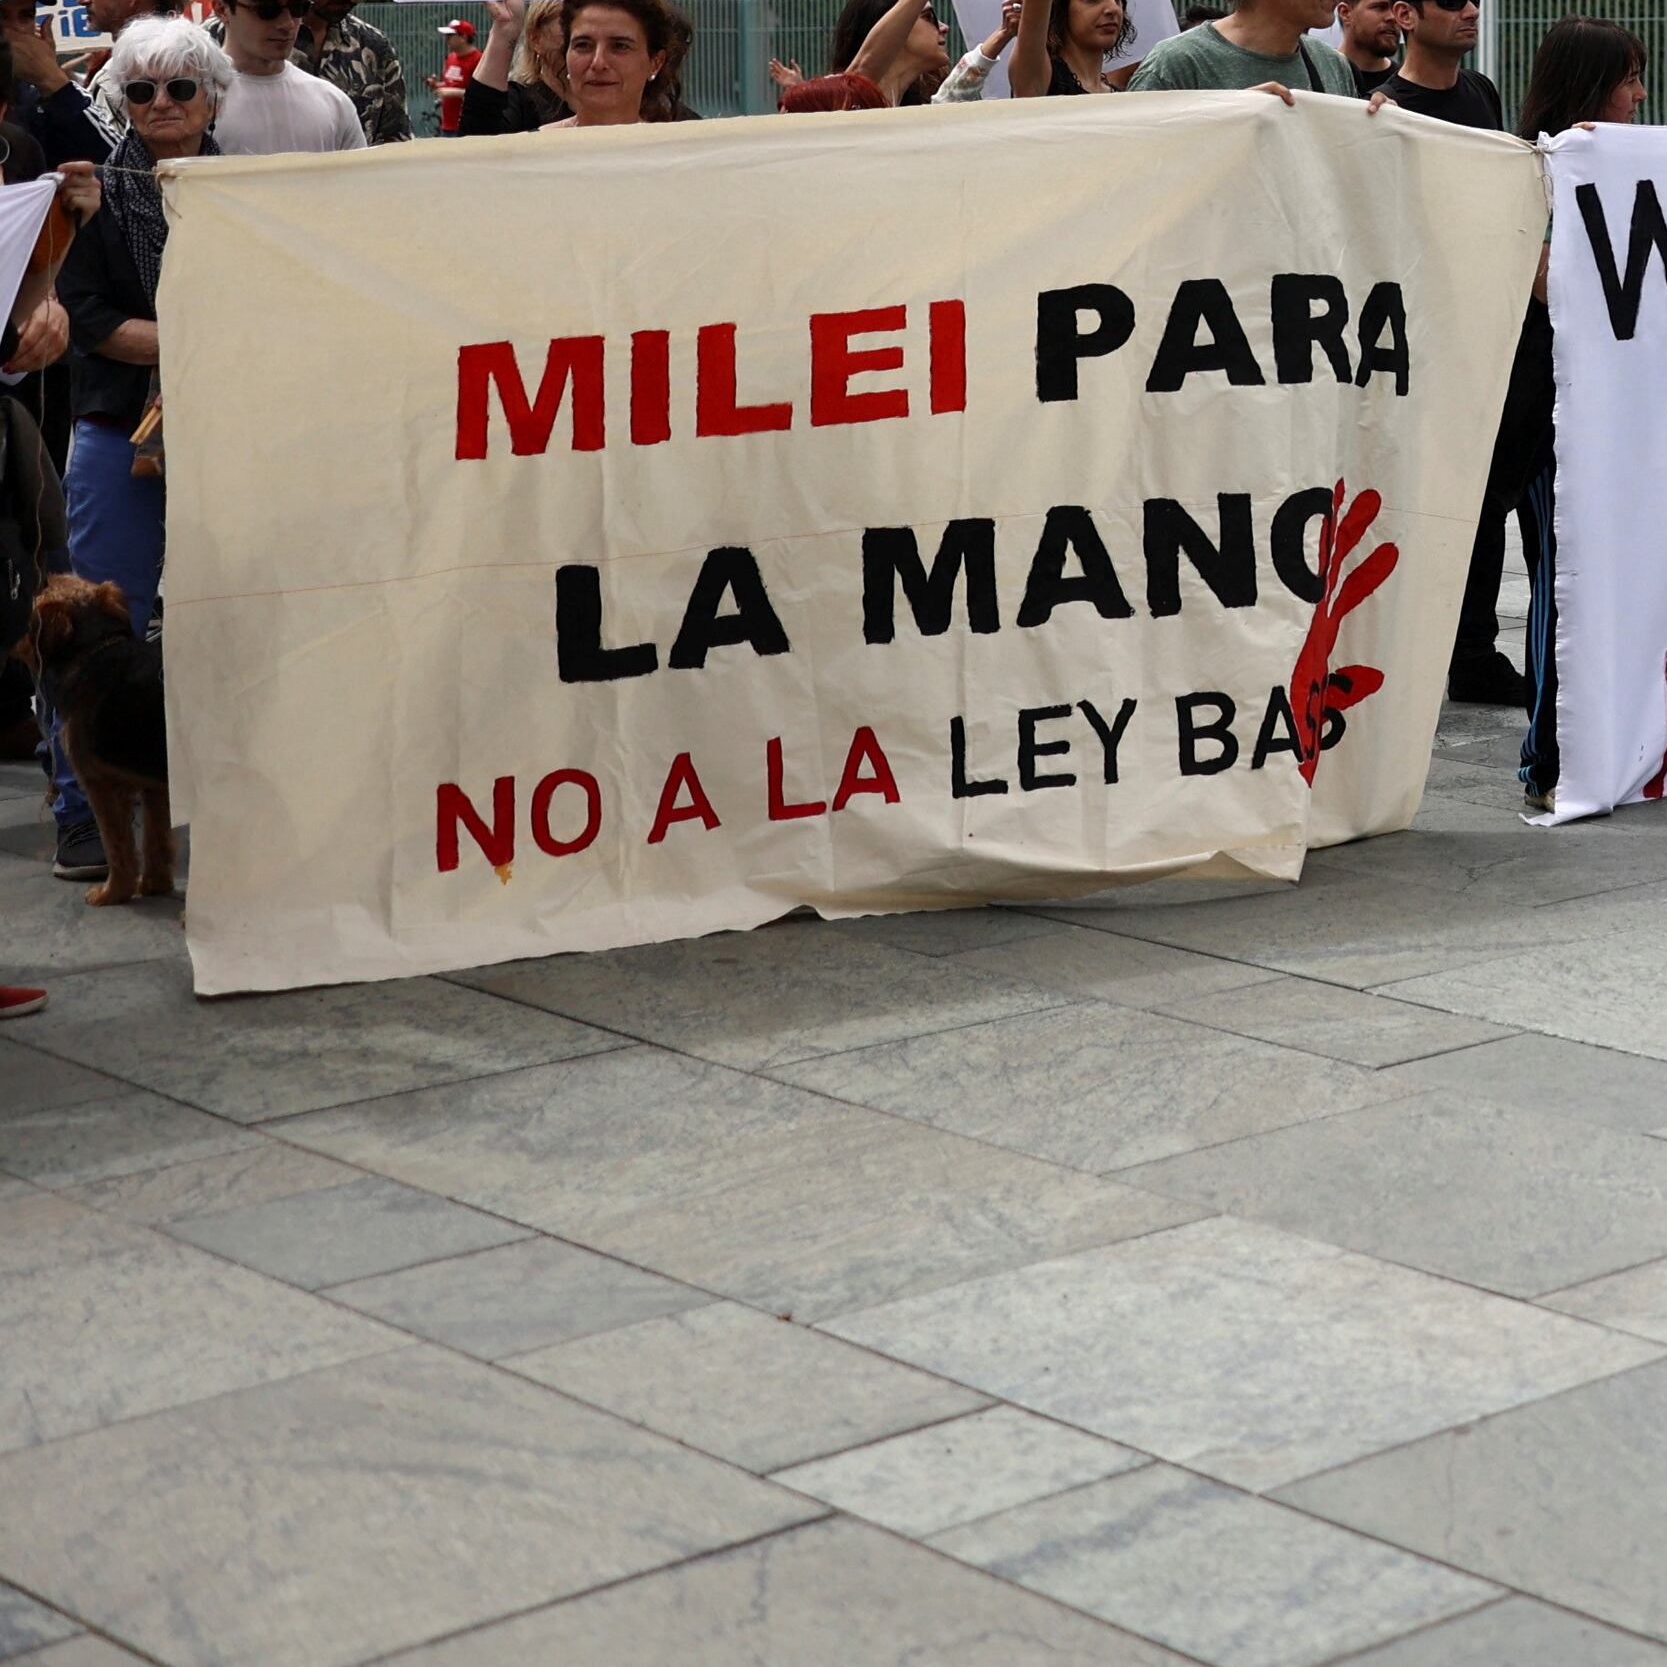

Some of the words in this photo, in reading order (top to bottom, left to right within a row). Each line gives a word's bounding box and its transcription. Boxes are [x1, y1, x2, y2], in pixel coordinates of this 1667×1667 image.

[454, 297, 967, 461] MILEI
[1035, 272, 1409, 404] PARA
[554, 544, 794, 684] LA
[860, 484, 1336, 646] MANO
[435, 767, 601, 874] NO
[646, 751, 723, 845] A
[766, 725, 902, 822] LA
[950, 696, 1138, 801] LEY
